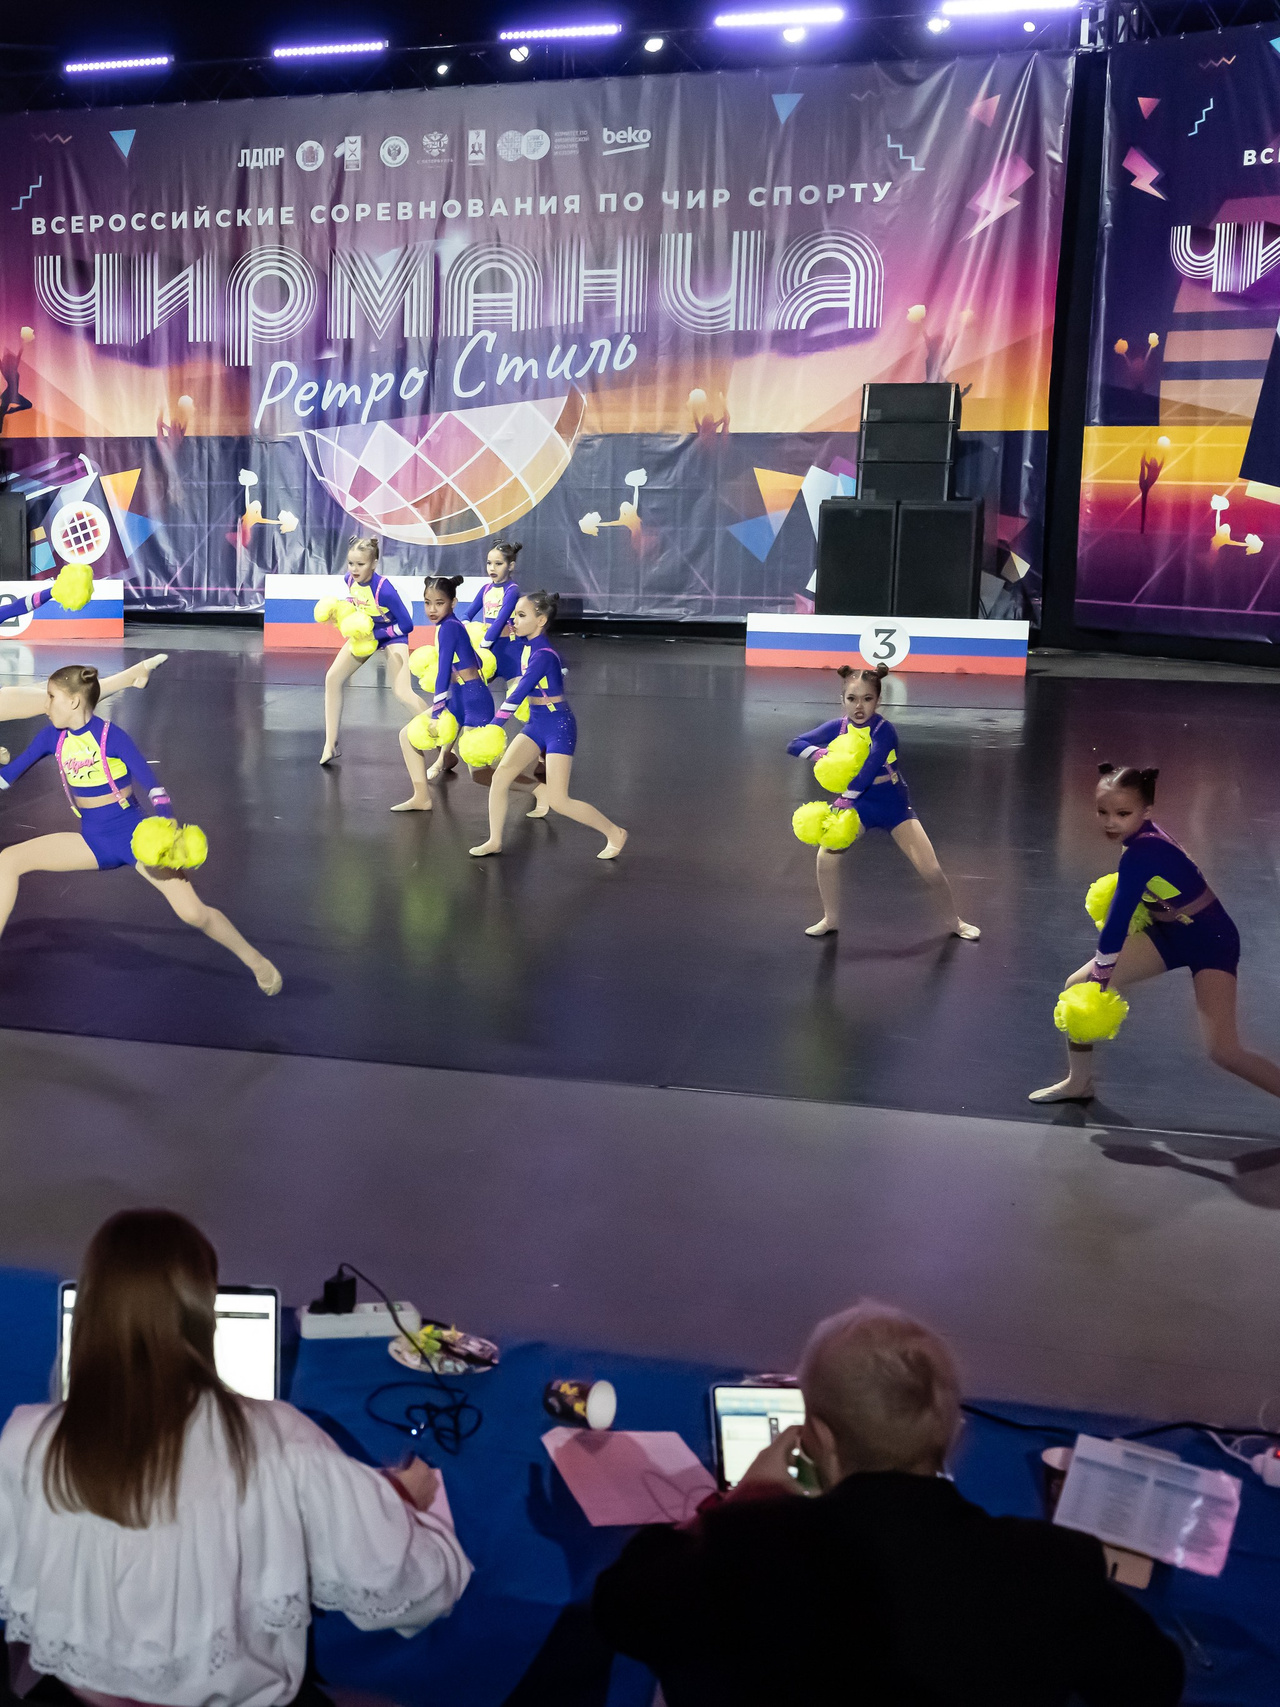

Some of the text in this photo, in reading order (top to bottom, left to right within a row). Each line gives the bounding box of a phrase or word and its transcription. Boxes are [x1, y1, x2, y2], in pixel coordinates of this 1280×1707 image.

[602, 126, 652, 144] beko
[237, 147, 285, 169] ЛДПР
[31, 181, 894, 236] ВСЕРОССИЙСКИЕ СОРЕВНОВАНИЯ ПО ЧИР СПОРТУ
[254, 329, 638, 429] Ретро Стиль
[872, 628, 897, 660] 3
